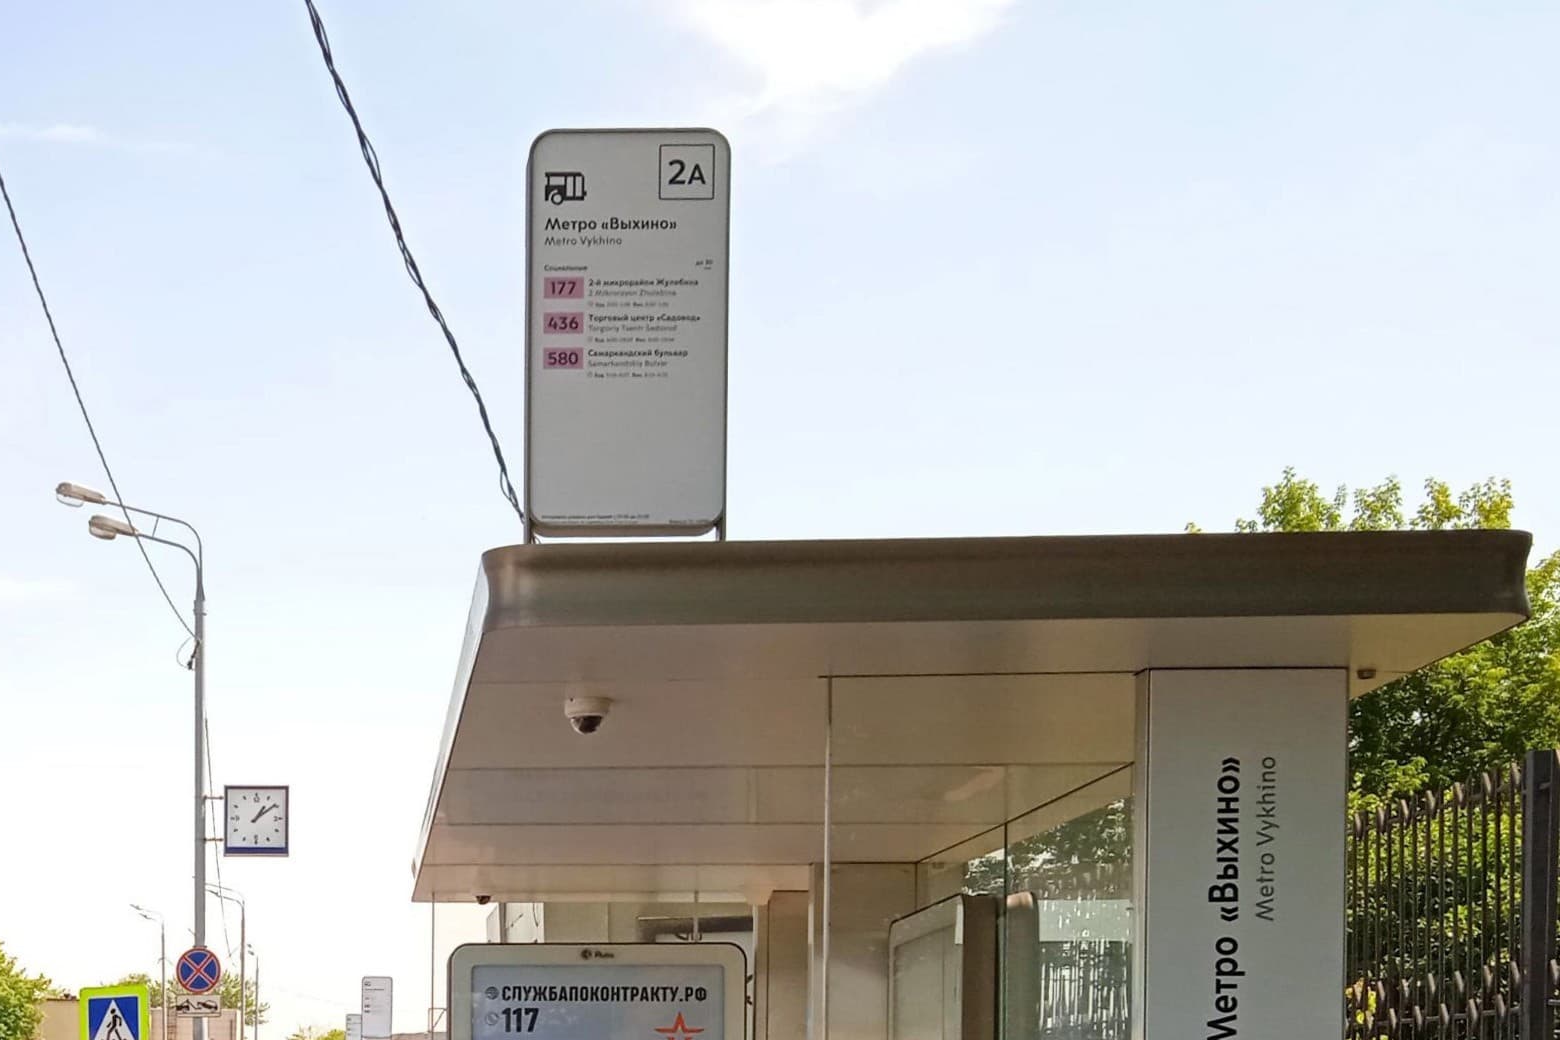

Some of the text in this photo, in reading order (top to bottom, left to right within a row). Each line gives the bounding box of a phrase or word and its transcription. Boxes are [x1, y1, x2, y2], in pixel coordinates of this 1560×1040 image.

[668, 159, 706, 185] 2А
[544, 217, 677, 232] Метро «Выхино»
[544, 236, 622, 247] Metro Vykhino
[550, 281, 577, 295] 177
[548, 316, 579, 330] 436
[547, 351, 578, 366] 580
[1208, 757, 1240, 922] «Выхино»
[1255, 756, 1280, 922] Metro Vykhino
[501, 985, 708, 1002] СЛУЖБАПОКОНТРАКТУ.РФ
[501, 1007, 540, 1033] 117
